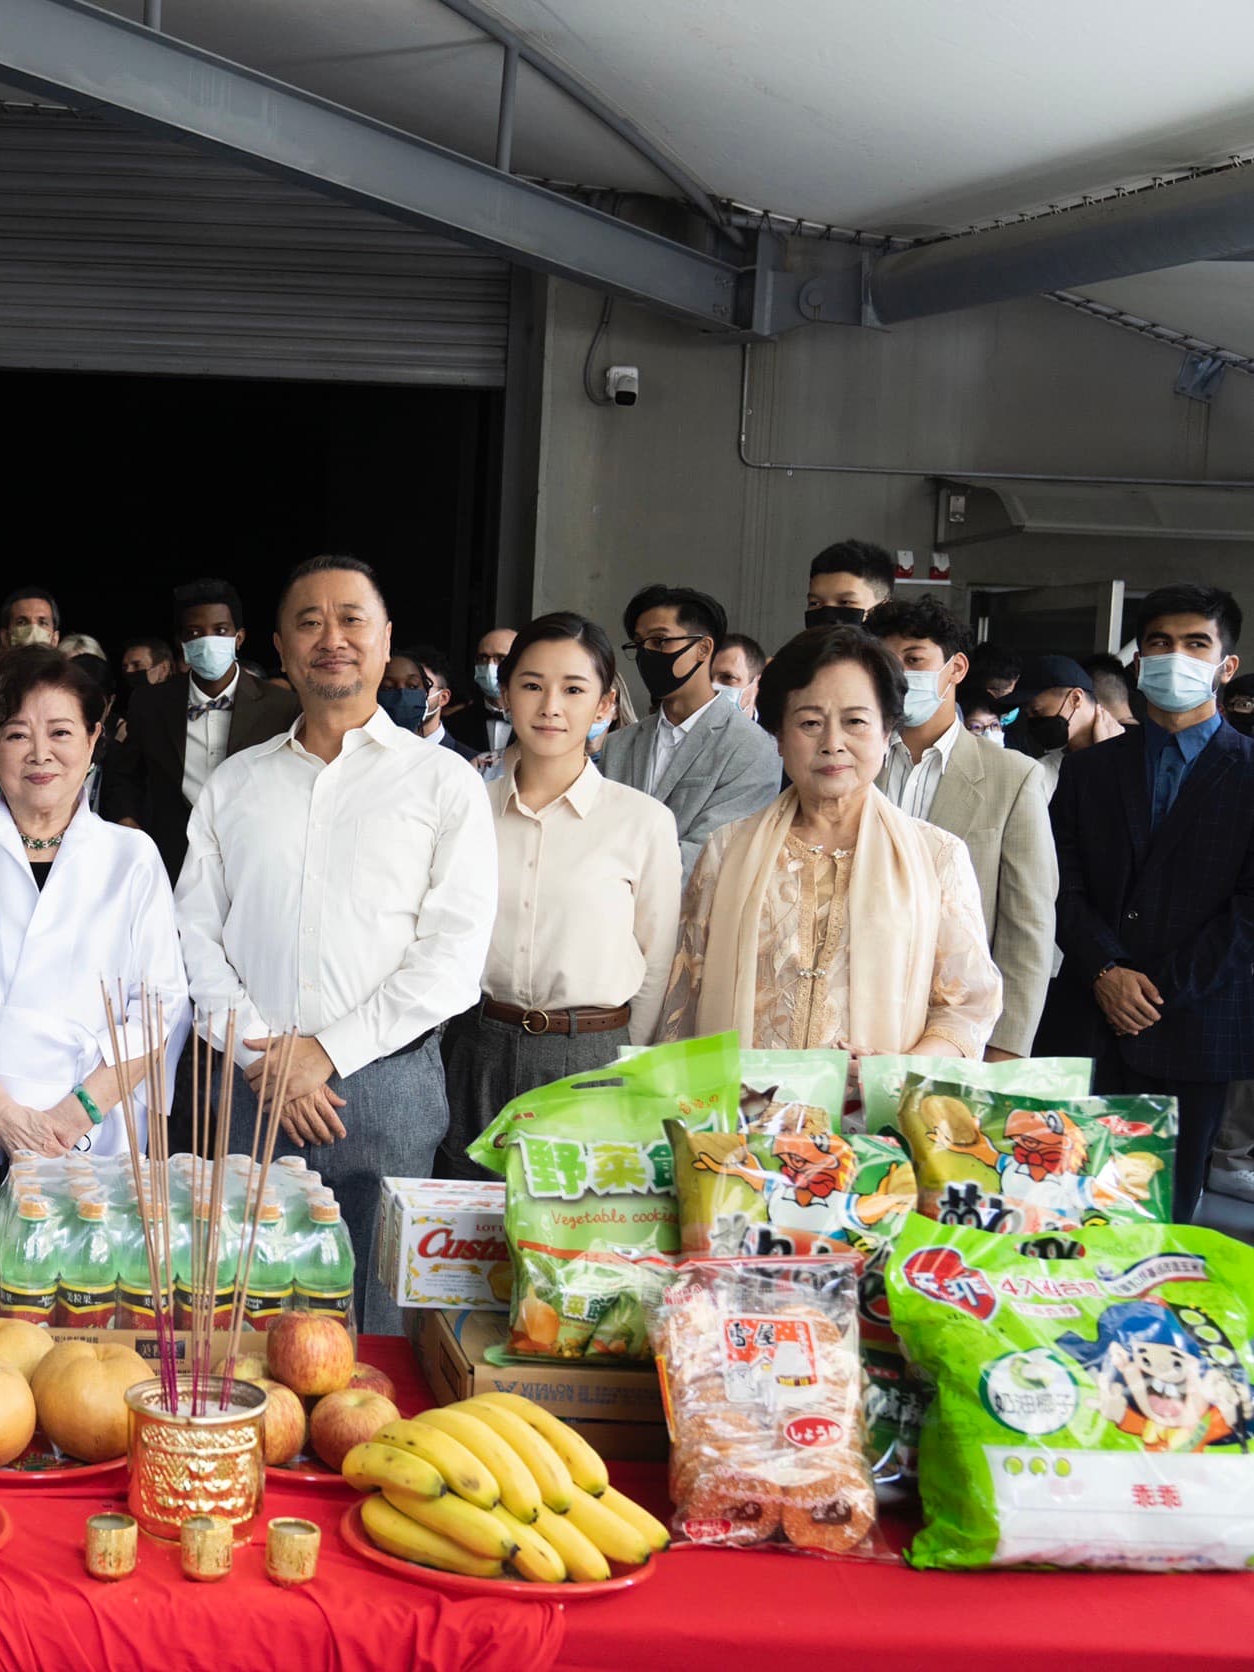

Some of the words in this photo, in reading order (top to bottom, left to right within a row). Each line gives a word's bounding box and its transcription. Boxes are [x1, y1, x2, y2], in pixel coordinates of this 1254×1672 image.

[475, 1224, 507, 1233] LOTT
[551, 1208, 627, 1230] Vegetable
[1131, 1484, 1182, 1509] 乖乖
